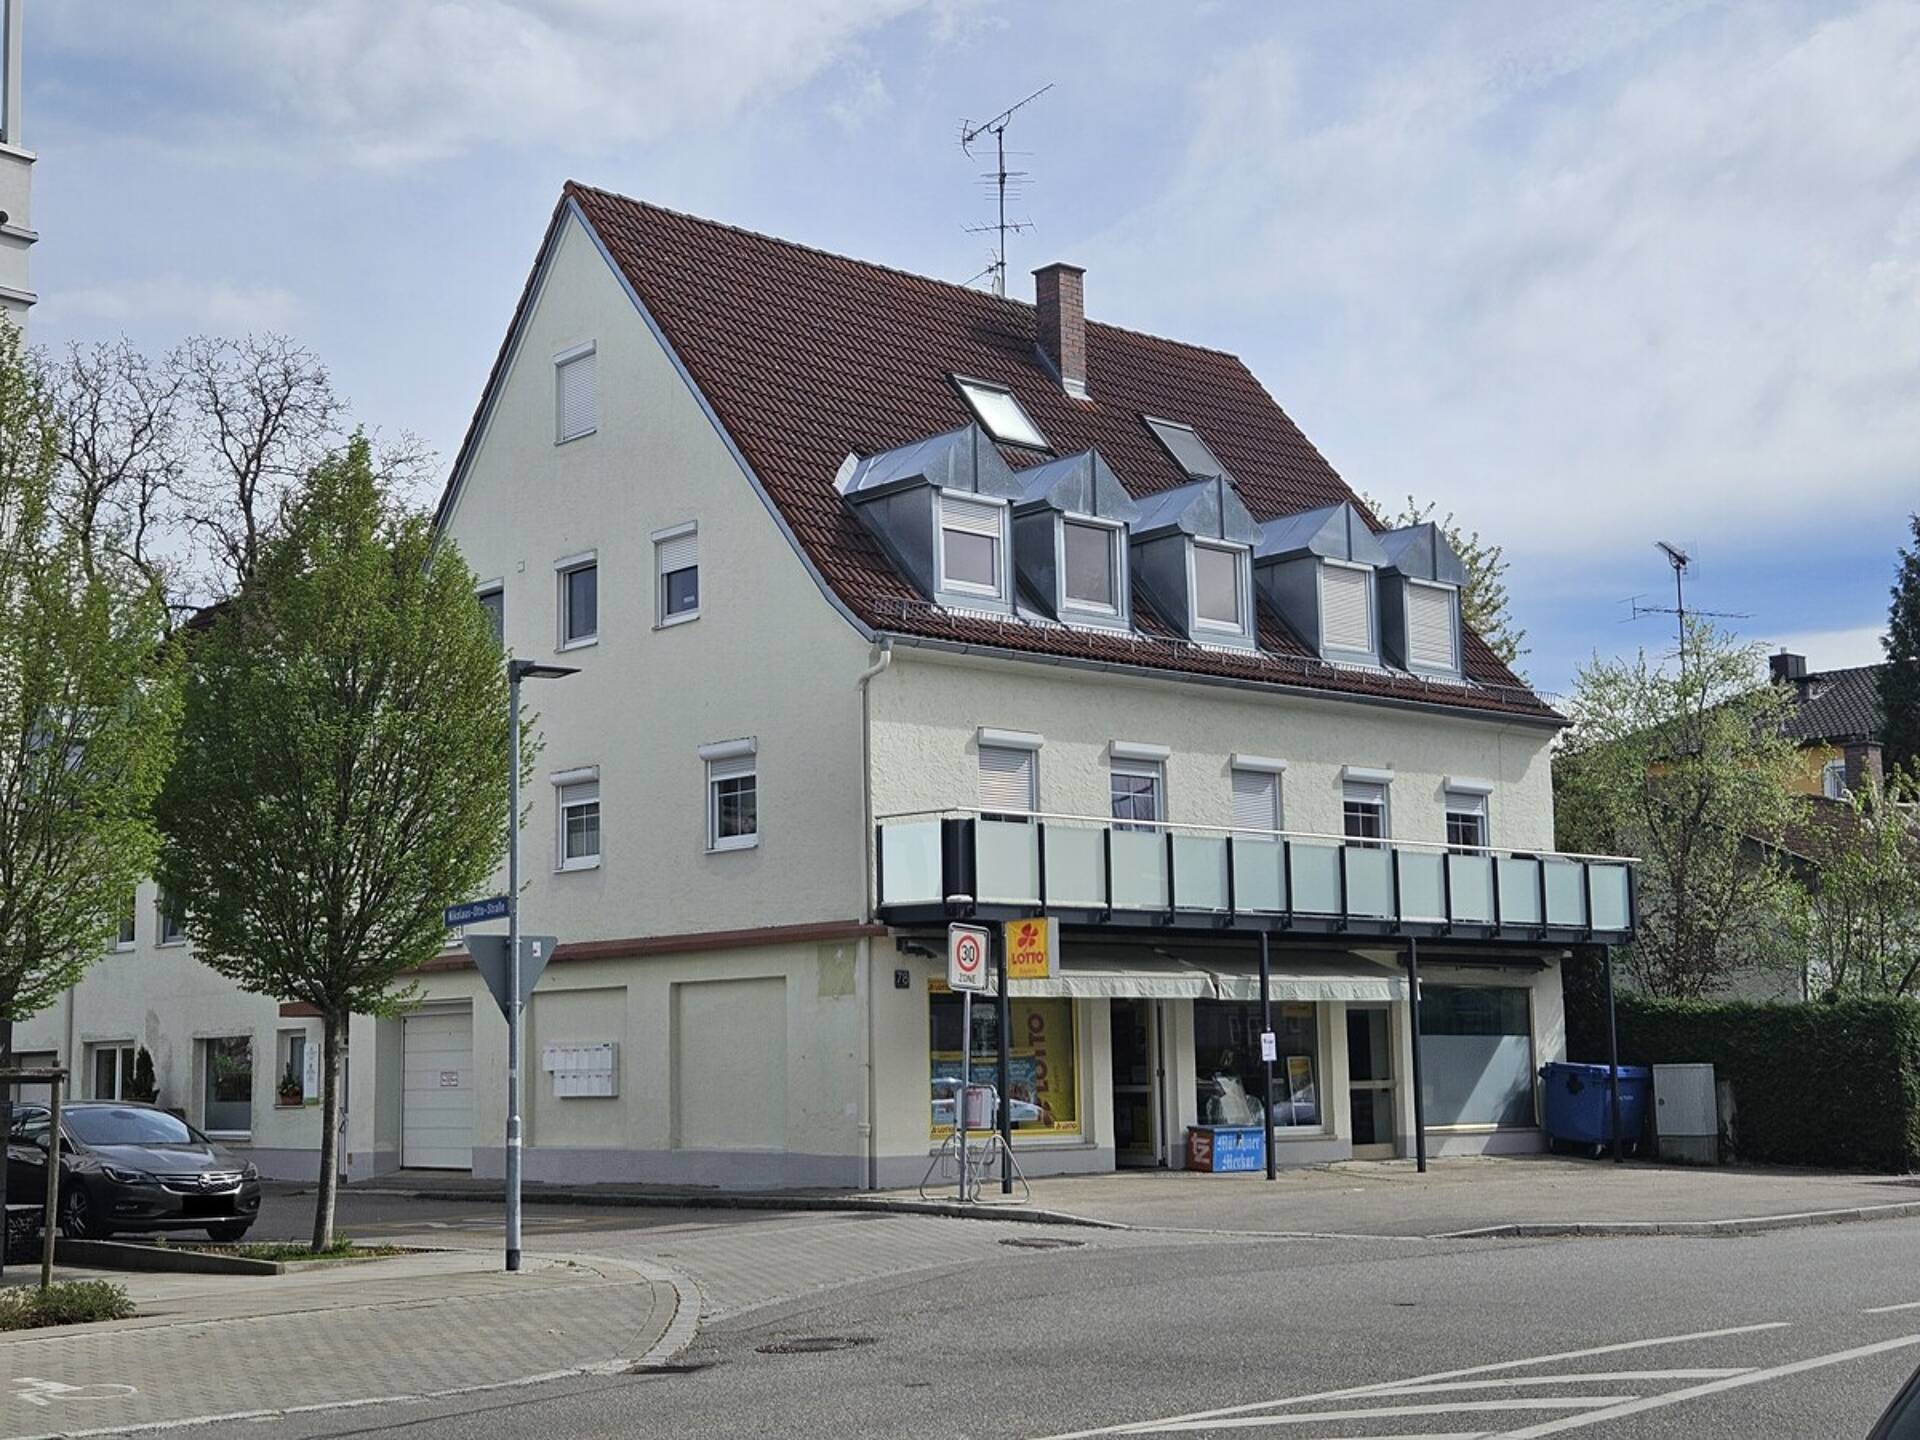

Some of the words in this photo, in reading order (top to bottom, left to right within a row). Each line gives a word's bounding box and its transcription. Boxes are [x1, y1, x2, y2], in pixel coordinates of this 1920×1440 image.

[961, 944, 975, 963] 30
[1011, 951, 1044, 965] LOTTO
[959, 973, 976, 985] ZONE
